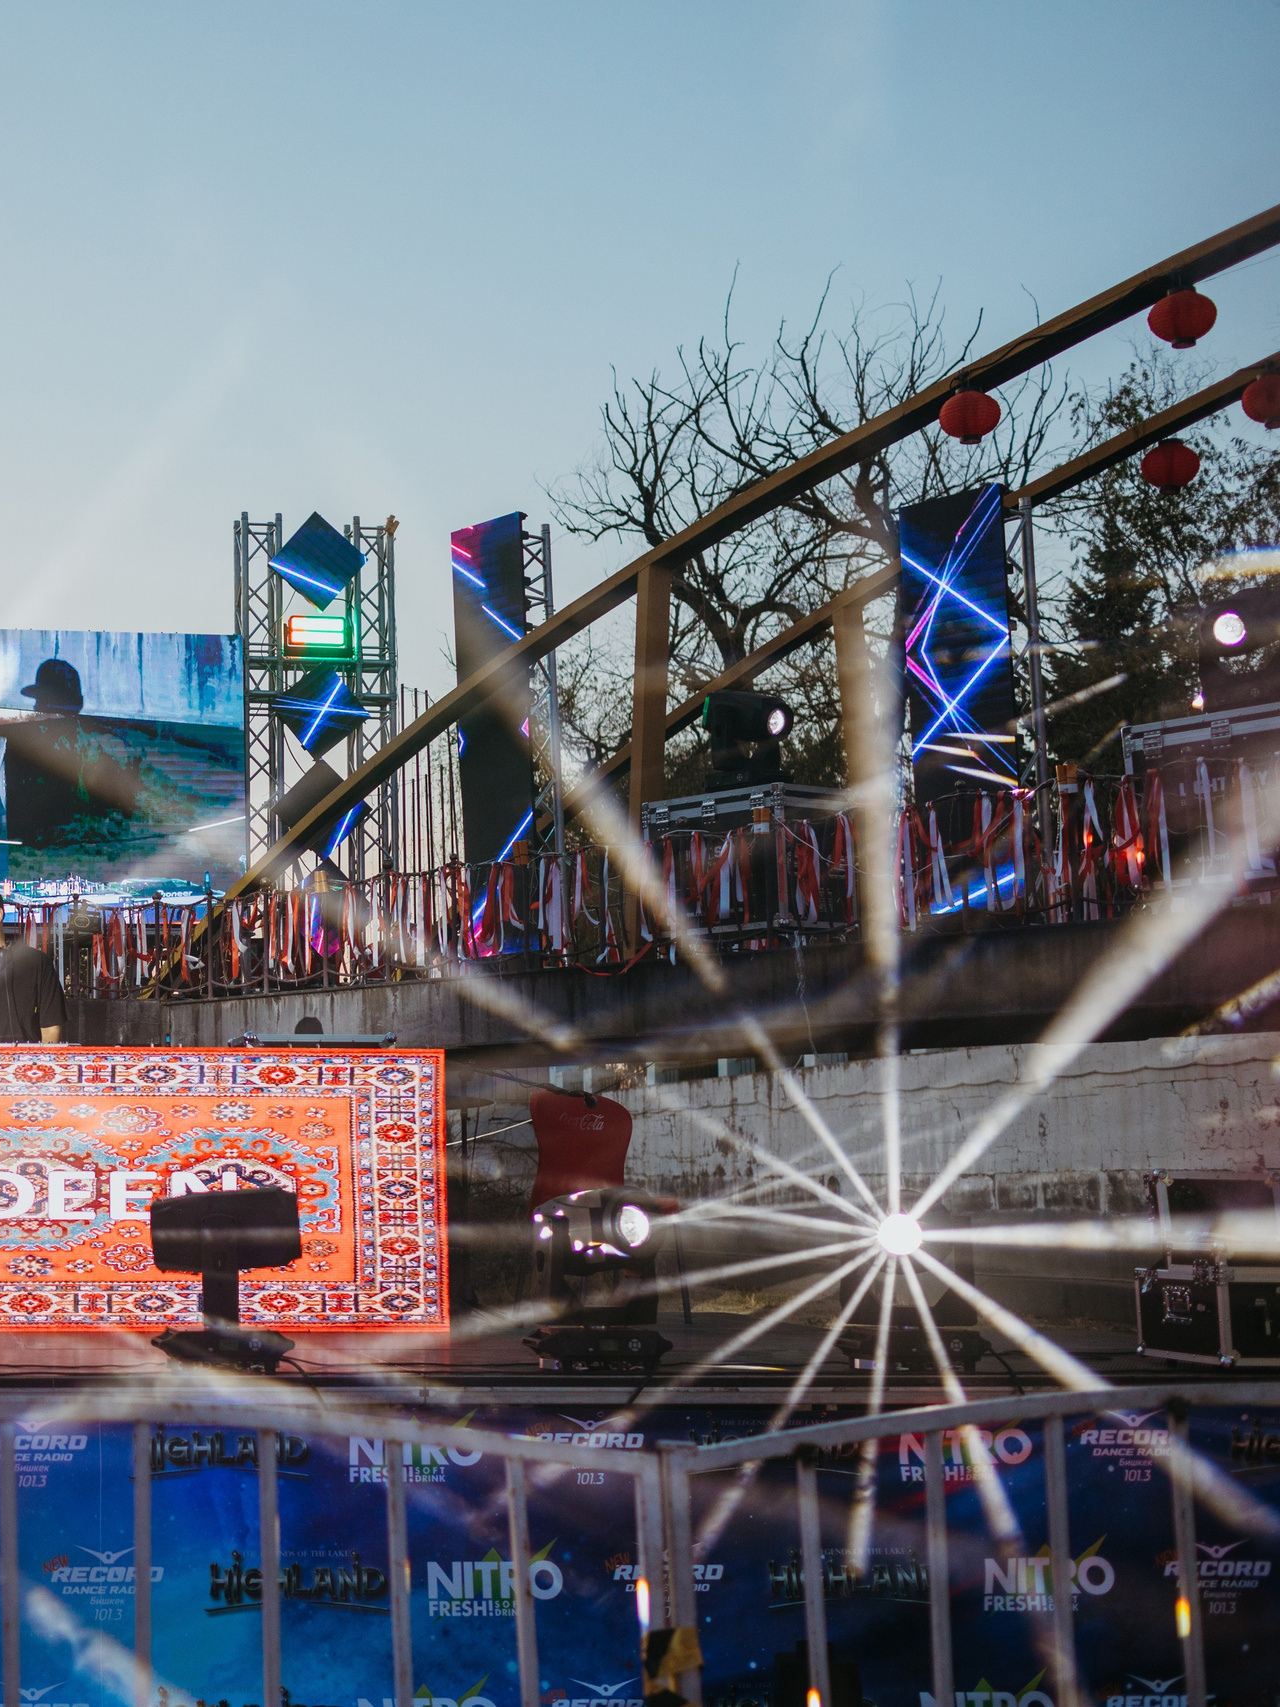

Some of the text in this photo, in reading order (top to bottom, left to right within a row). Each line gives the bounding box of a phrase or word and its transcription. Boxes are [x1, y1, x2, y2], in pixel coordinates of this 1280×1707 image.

[1080, 1429, 1169, 1445] RECOR
[149, 1428, 309, 1471] IGHLAD
[1093, 1448, 1134, 1456] DANCE
[33, 1453, 73, 1461] RADIO
[415, 1467, 445, 1475] SOFT
[1124, 1470, 1151, 1482] 101.3
[19, 1475, 47, 1487] 101.3
[415, 1475, 446, 1483] DRINK
[577, 1473, 605, 1485] 101.3
[42, 1554, 70, 1576] NEW
[1164, 1561, 1271, 1577] RCORD
[1221, 1580, 1259, 1588] RADIO
[62, 1586, 136, 1595] DANCE RAD
[428, 1600, 494, 1617] FRESH!
[495, 1600, 517, 1609] SOF
[983, 1595, 1047, 1612] FRESH!
[1209, 1601, 1236, 1614] 101.3
[94, 1608, 123, 1621] 101.3
[495, 1608, 520, 1617] DRIN
